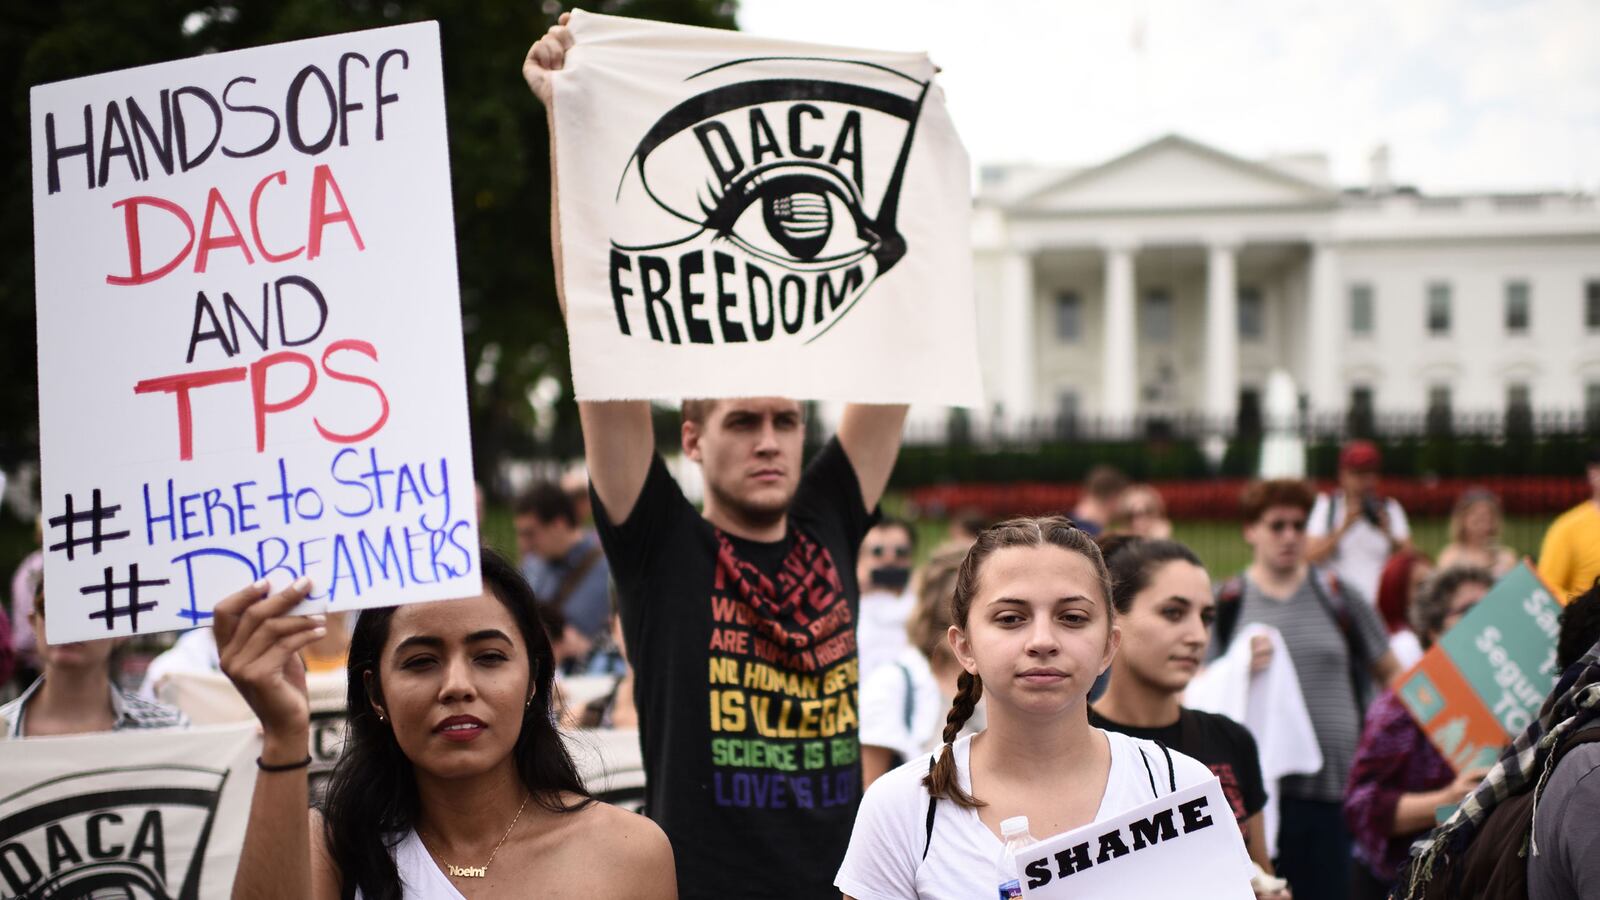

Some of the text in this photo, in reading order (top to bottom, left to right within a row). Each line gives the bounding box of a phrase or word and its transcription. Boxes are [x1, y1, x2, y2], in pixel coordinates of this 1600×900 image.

[45, 49, 409, 195] HANDS OFF
[692, 103, 864, 203] DACA
[106, 164, 365, 286] DACA
[186, 275, 328, 364] AND
[610, 249, 864, 345] FREEDOM
[134, 339, 390, 460] TPS
[709, 628, 750, 655] ARE
[744, 661, 819, 700] HUMAN
[709, 690, 859, 738] IS ILLEGA
[803, 741, 825, 770] IS
[714, 772, 787, 808] LOVE
[0, 809, 168, 899] DACA
[1025, 796, 1214, 890] SHAME
